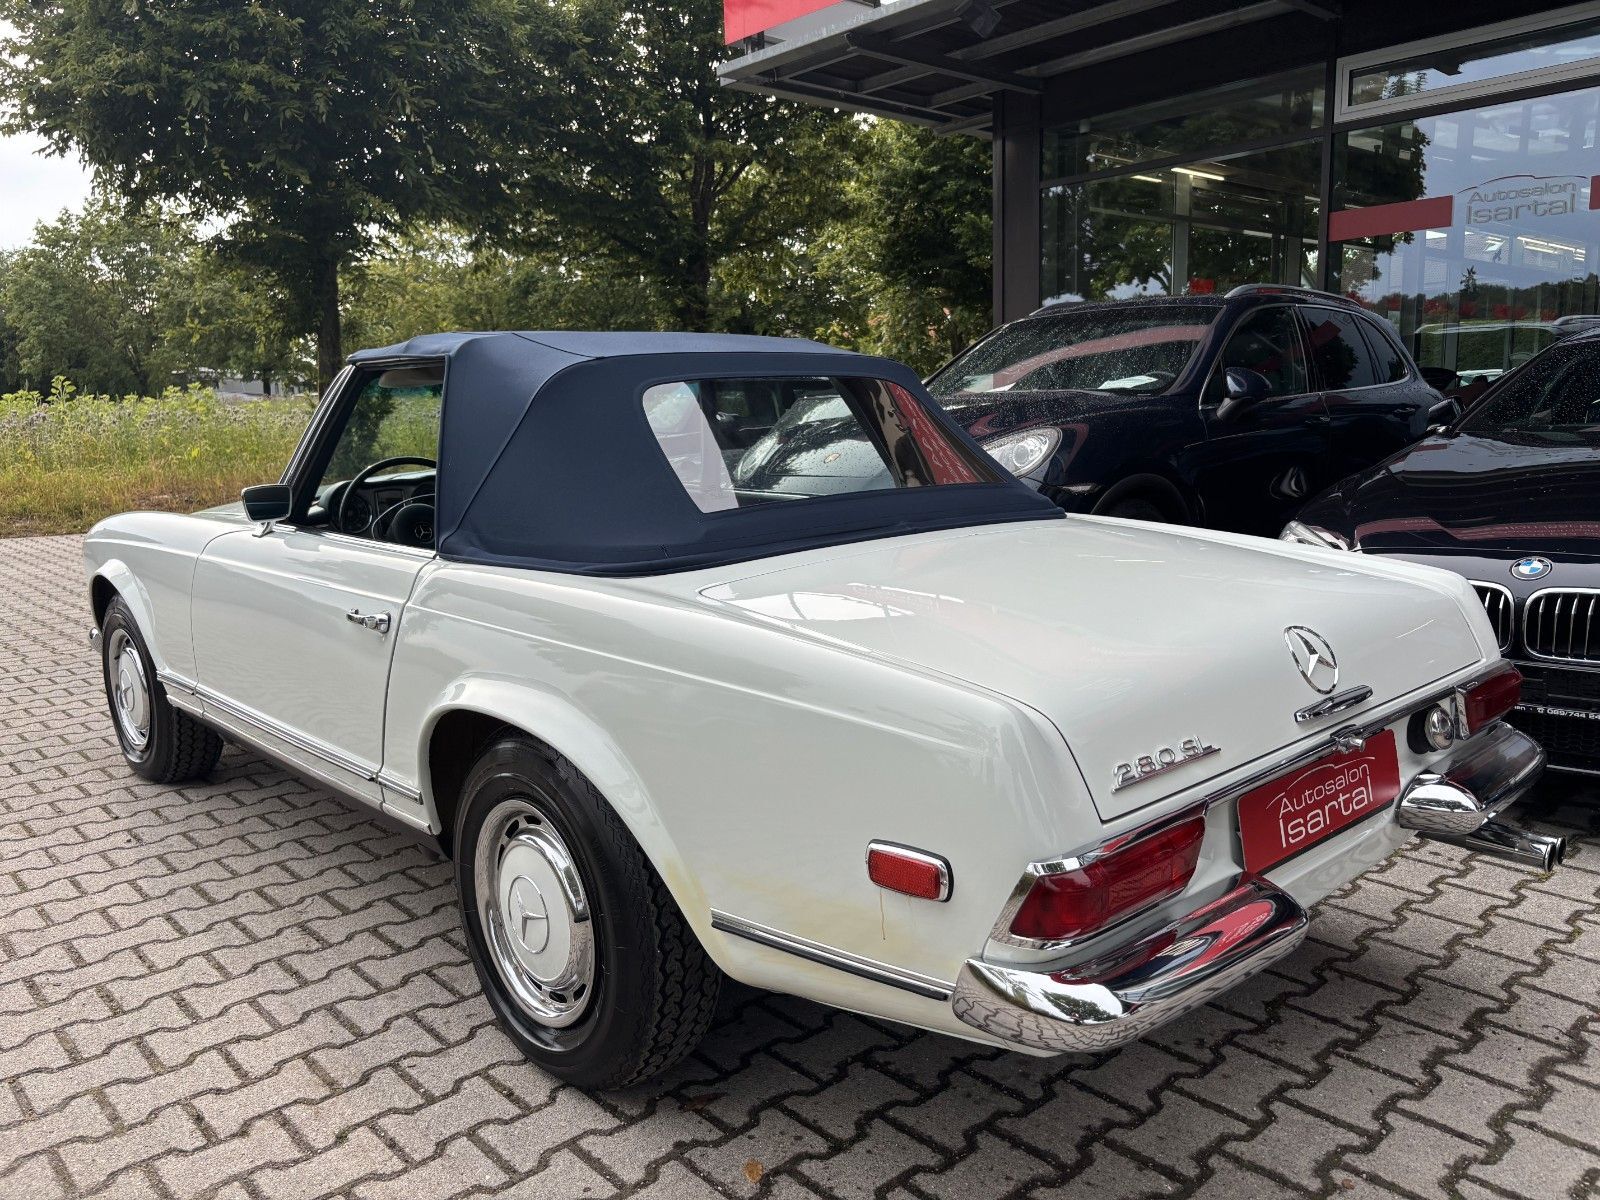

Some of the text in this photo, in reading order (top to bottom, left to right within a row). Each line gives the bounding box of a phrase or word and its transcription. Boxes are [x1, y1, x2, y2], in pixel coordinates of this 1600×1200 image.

[1466, 192, 1576, 224] Isartal
[1467, 182, 1577, 204] Autosalon
[1112, 735, 1213, 787] 280 SL
[1279, 763, 1370, 819] Autosalon
[1279, 775, 1374, 849] Isartal
